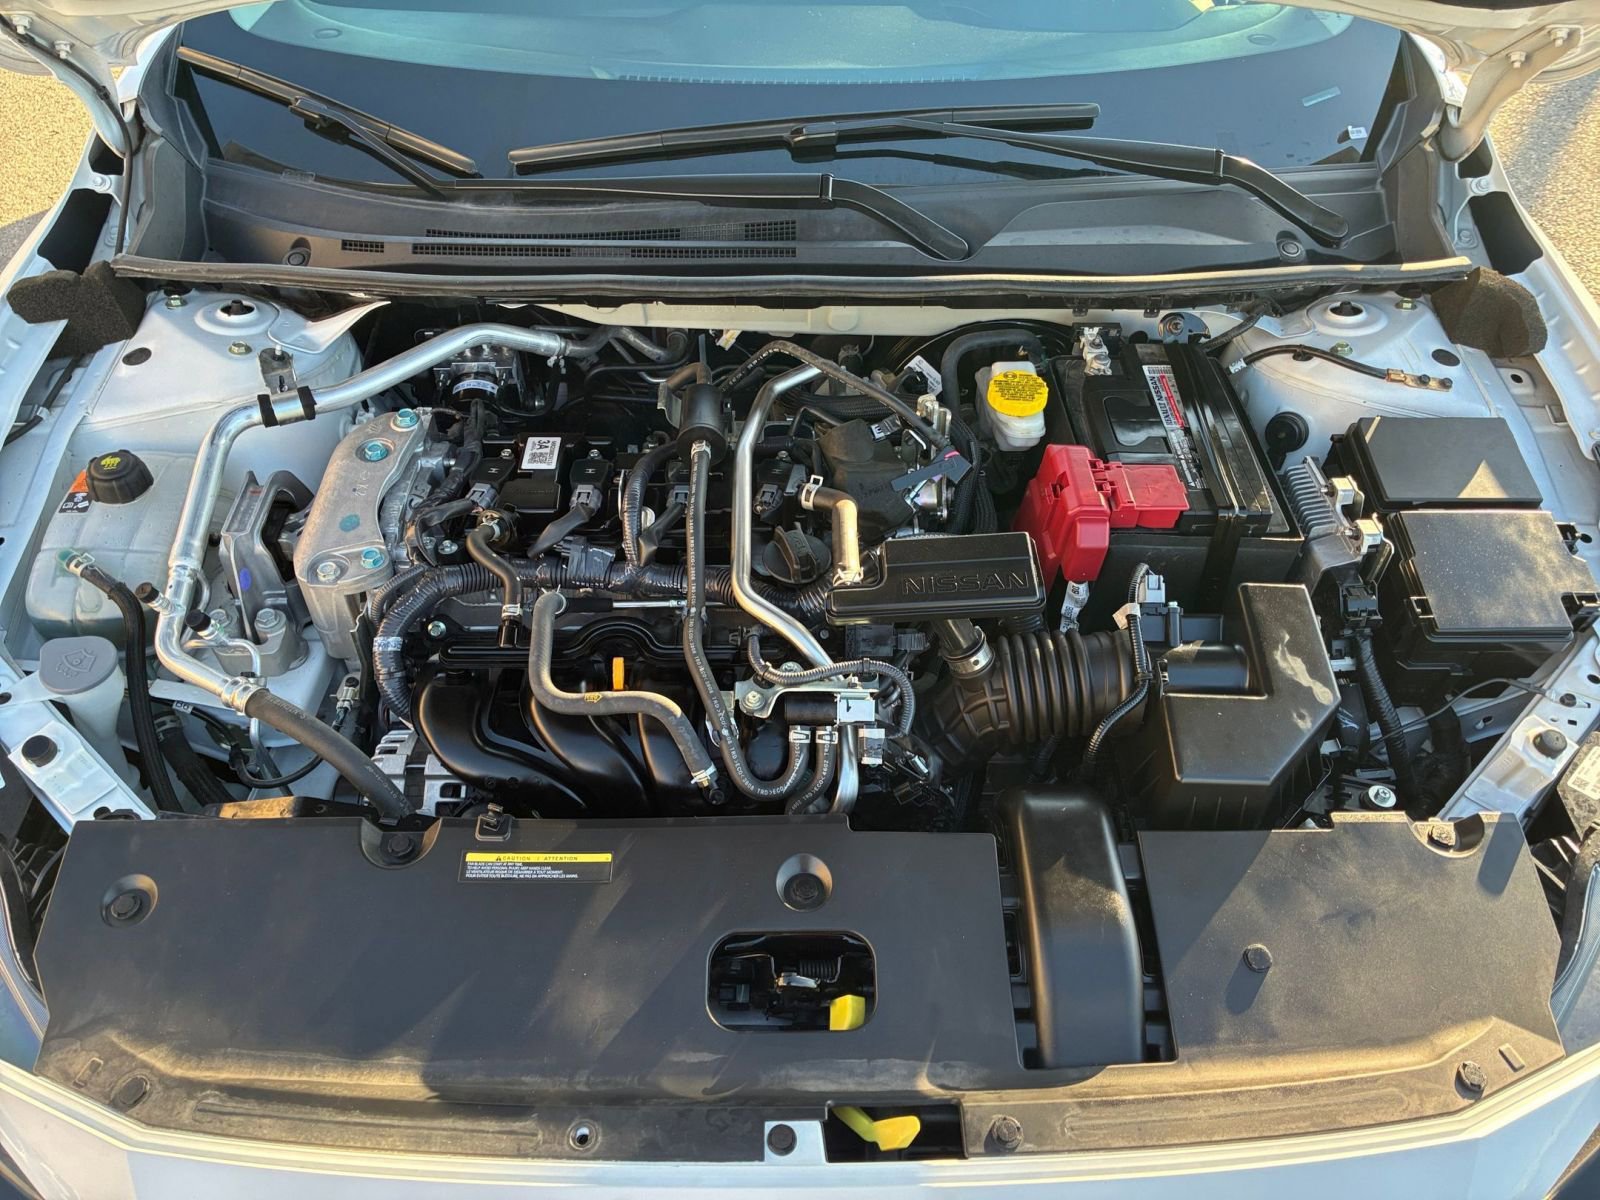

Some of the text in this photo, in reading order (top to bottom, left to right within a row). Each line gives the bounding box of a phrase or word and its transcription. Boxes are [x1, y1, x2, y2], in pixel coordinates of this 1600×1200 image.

[1148, 375, 1163, 402] NISSAN
[537, 440, 551, 450] 3A
[903, 571, 1030, 595] NISSAN
